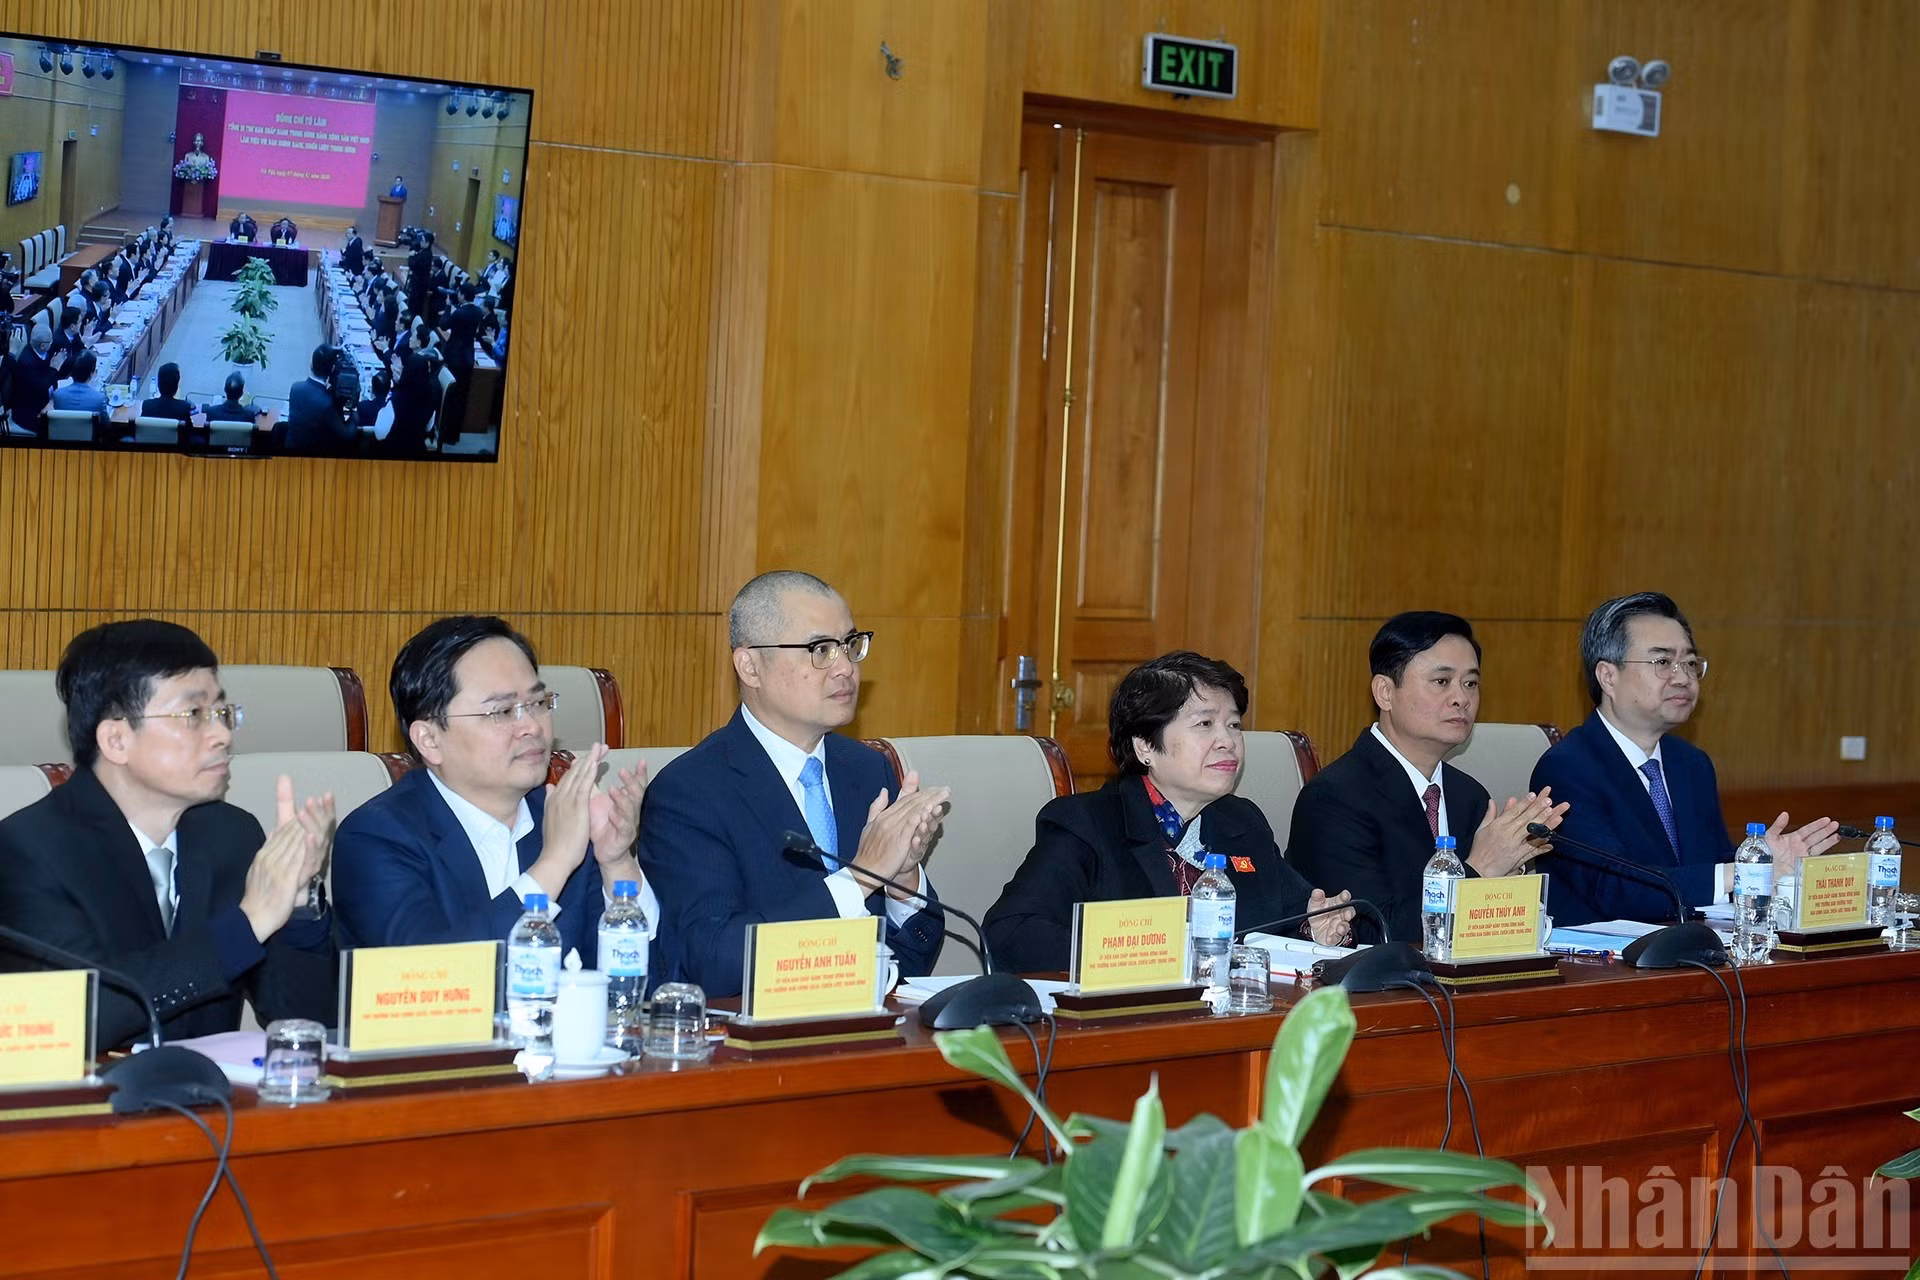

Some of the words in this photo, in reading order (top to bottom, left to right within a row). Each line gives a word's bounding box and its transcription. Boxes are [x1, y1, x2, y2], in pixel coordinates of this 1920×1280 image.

[1161, 45, 1224, 87] EXIT
[1502, 890, 1513, 899] CHÍ
[1512, 906, 1525, 917] ANH
[1119, 918, 1139, 928] ĐỒNG
[1140, 918, 1152, 926] CHÍ
[822, 937, 837, 947] CHÍ
[1102, 936, 1125, 951] PHẠM
[1126, 935, 1139, 949] ĐẠI
[1141, 933, 1167, 946] DƯƠNG
[776, 953, 811, 972] NGUYỄN
[813, 956, 832, 969] ANH
[835, 950, 856, 966] TUẤN
[420, 990, 439, 1003] DUY
